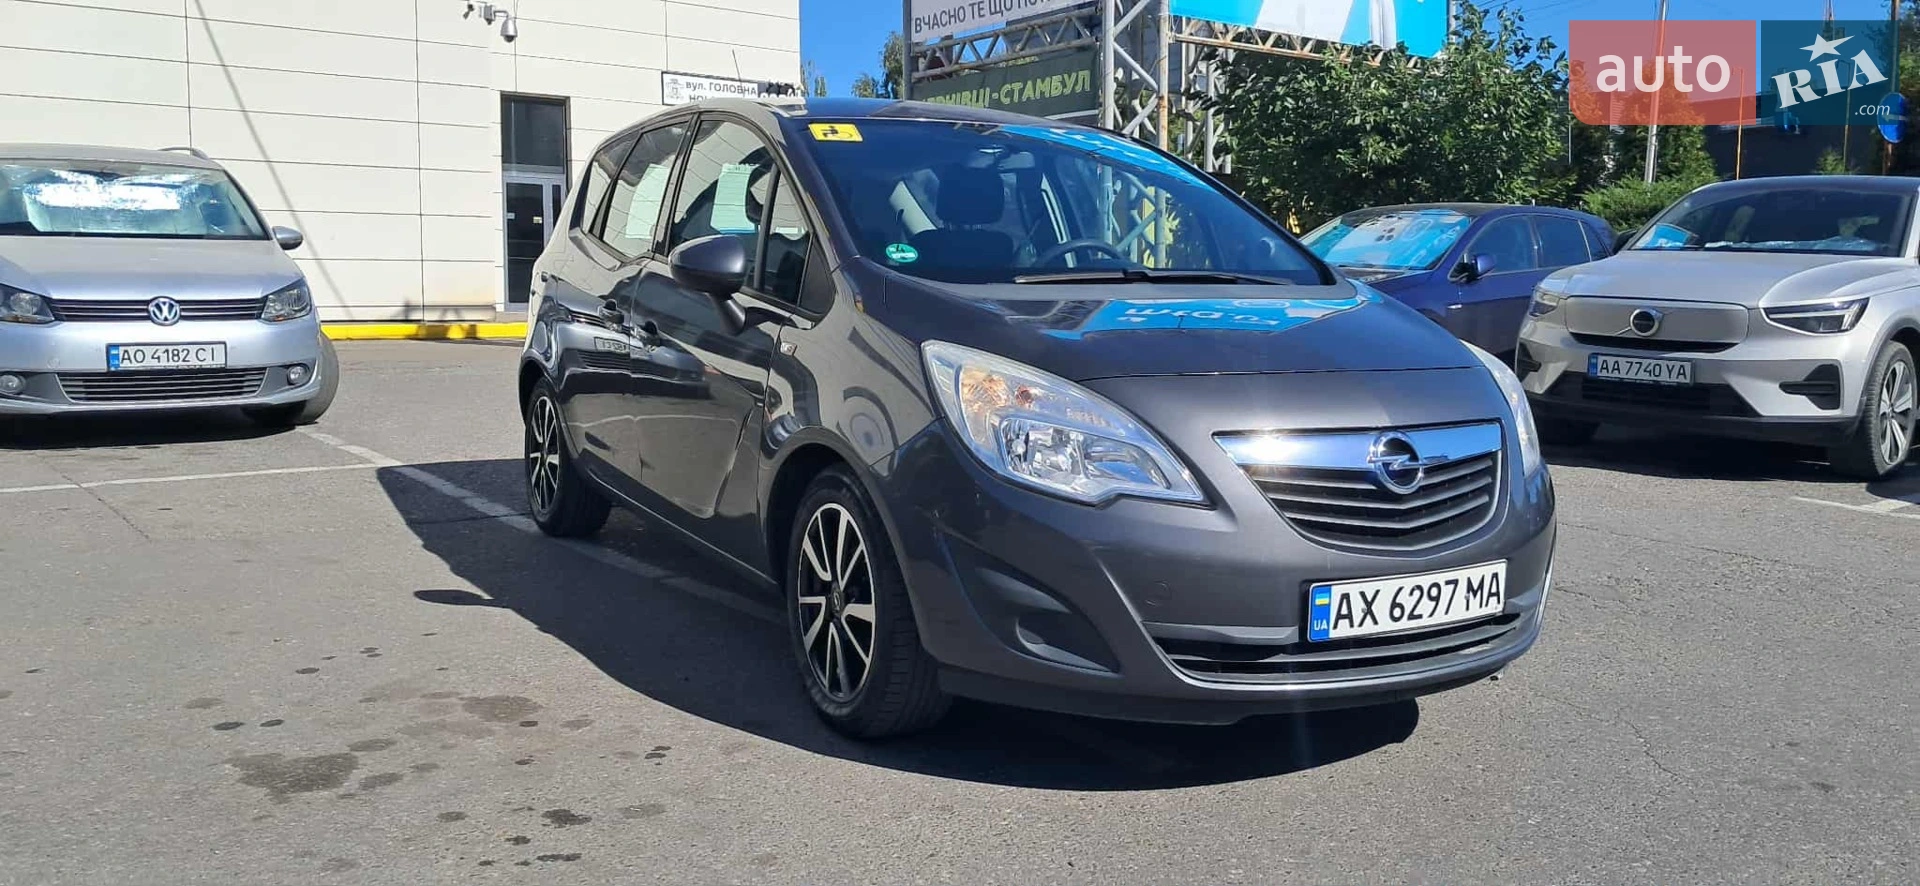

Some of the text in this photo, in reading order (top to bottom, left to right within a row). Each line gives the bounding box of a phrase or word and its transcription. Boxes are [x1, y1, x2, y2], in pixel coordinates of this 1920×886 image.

[914, 6, 967, 34] ВЧАСНО
[968, 1, 987, 20] ТЕ
[709, 82, 757, 95] ГОЛОВНА
[120, 349, 146, 364] AO
[151, 348, 191, 363] 4182
[1600, 359, 1621, 375] AA
[1625, 360, 1662, 378] 7740
[1665, 364, 1687, 380] YA
[1332, 571, 1501, 630] AX 6297 MA
[1314, 619, 1328, 630] UA
